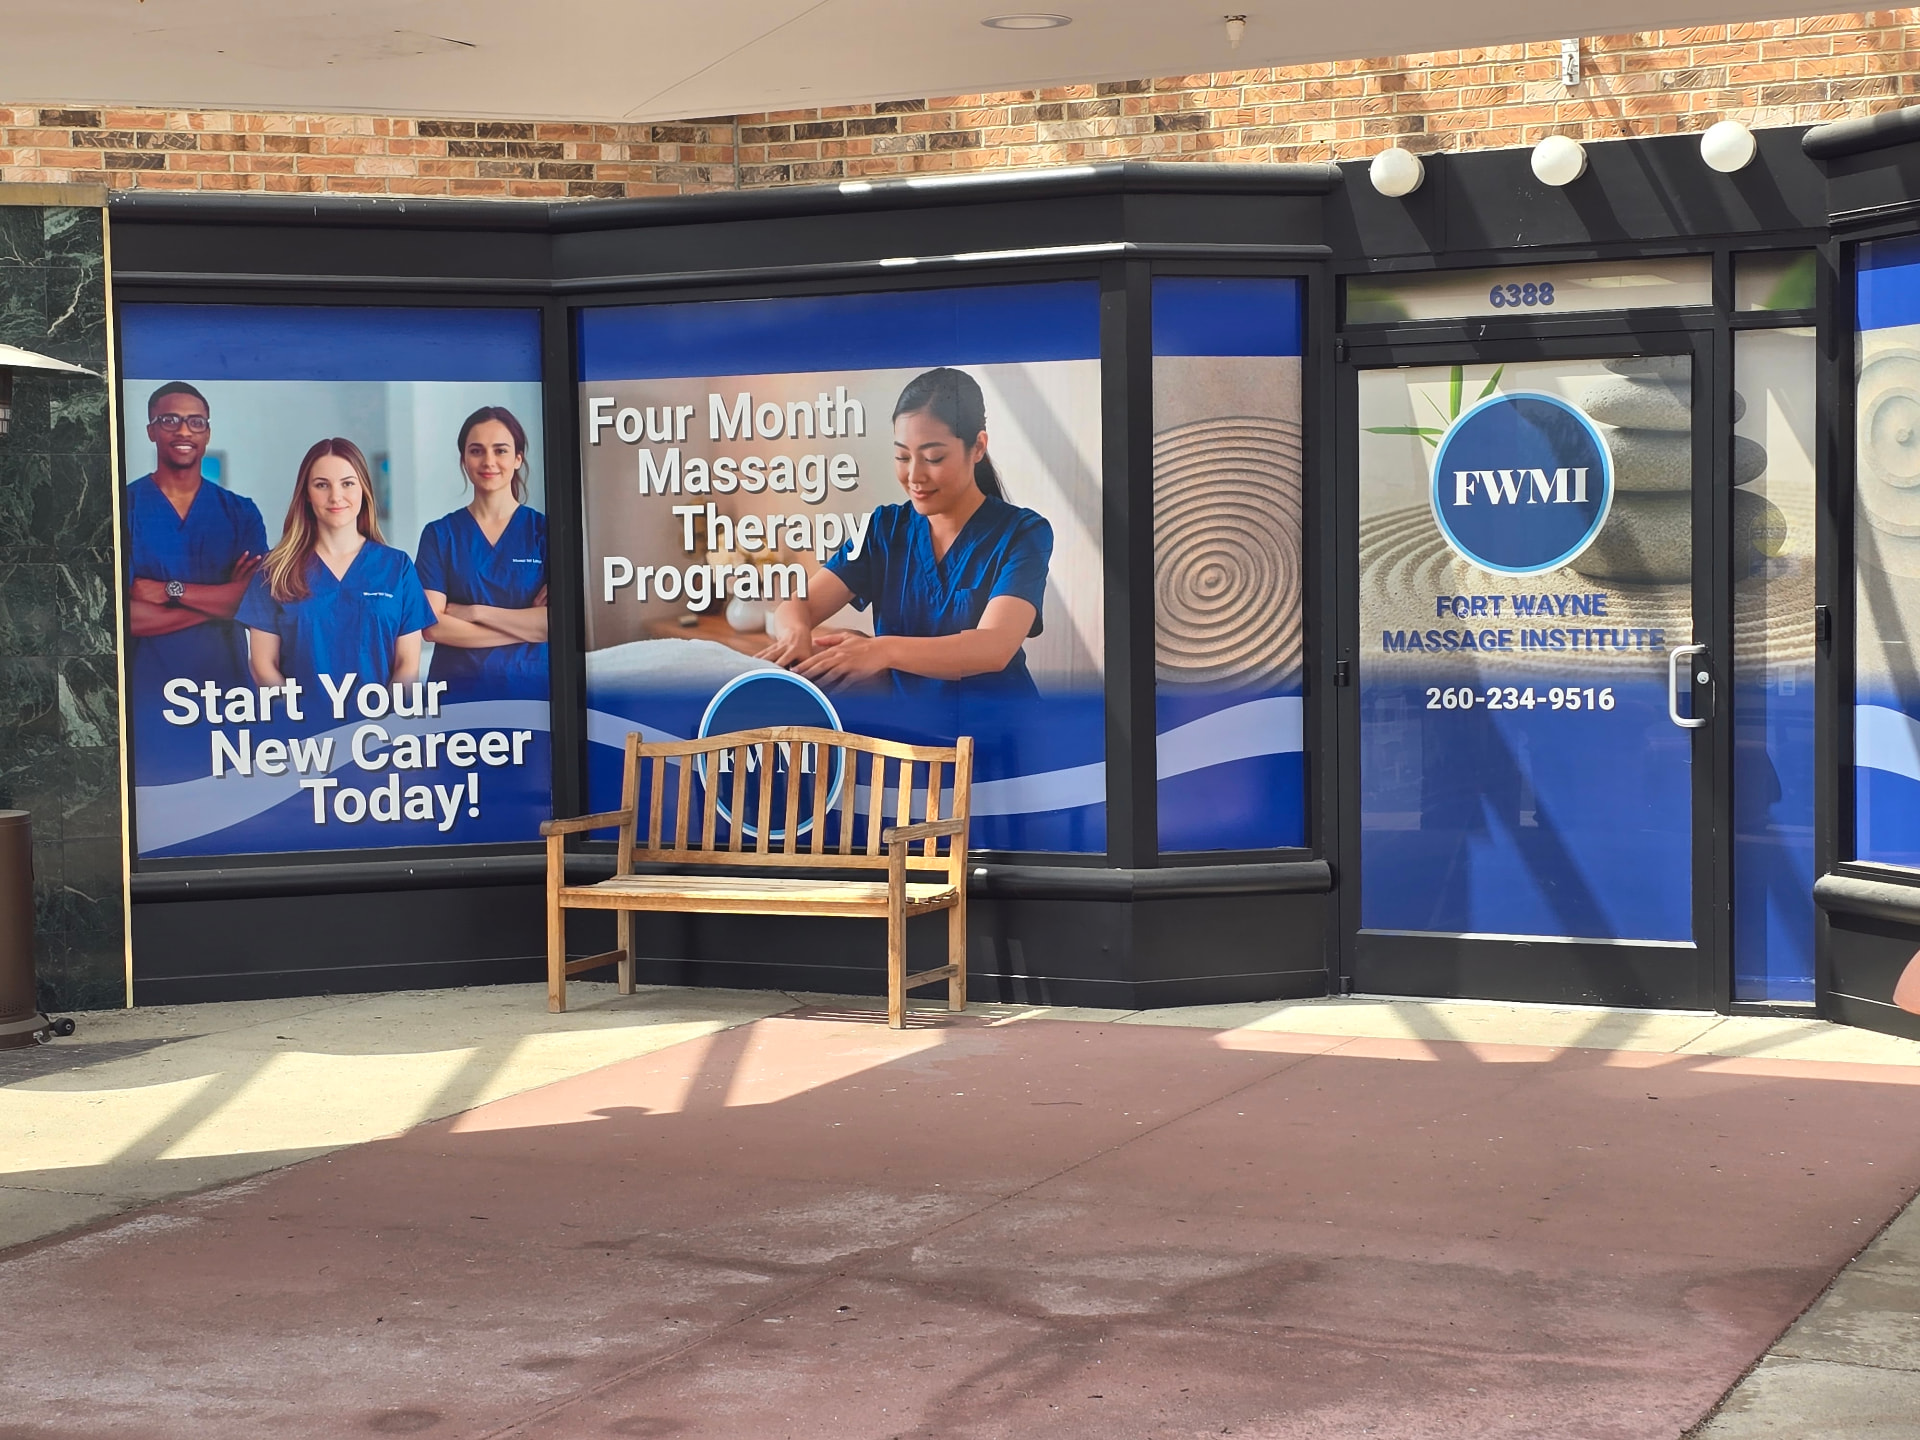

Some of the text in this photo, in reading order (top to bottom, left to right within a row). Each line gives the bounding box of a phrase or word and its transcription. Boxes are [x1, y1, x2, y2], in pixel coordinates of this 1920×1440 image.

[1489, 282, 1555, 308] 6388
[589, 386, 865, 443] Four Month
[639, 448, 859, 502] Massage
[1453, 467, 1590, 506] FWMI
[672, 502, 872, 561] Therapy
[603, 556, 807, 612] Program
[1436, 595, 1505, 618] FORT
[1511, 594, 1608, 616] WAYNE
[1382, 628, 1665, 652] MASSAGE INSTITUTE
[162, 673, 448, 725] Start Your
[1426, 687, 1616, 711] 260-234-9516
[210, 724, 533, 776] New Career
[299, 773, 481, 832] Today!
